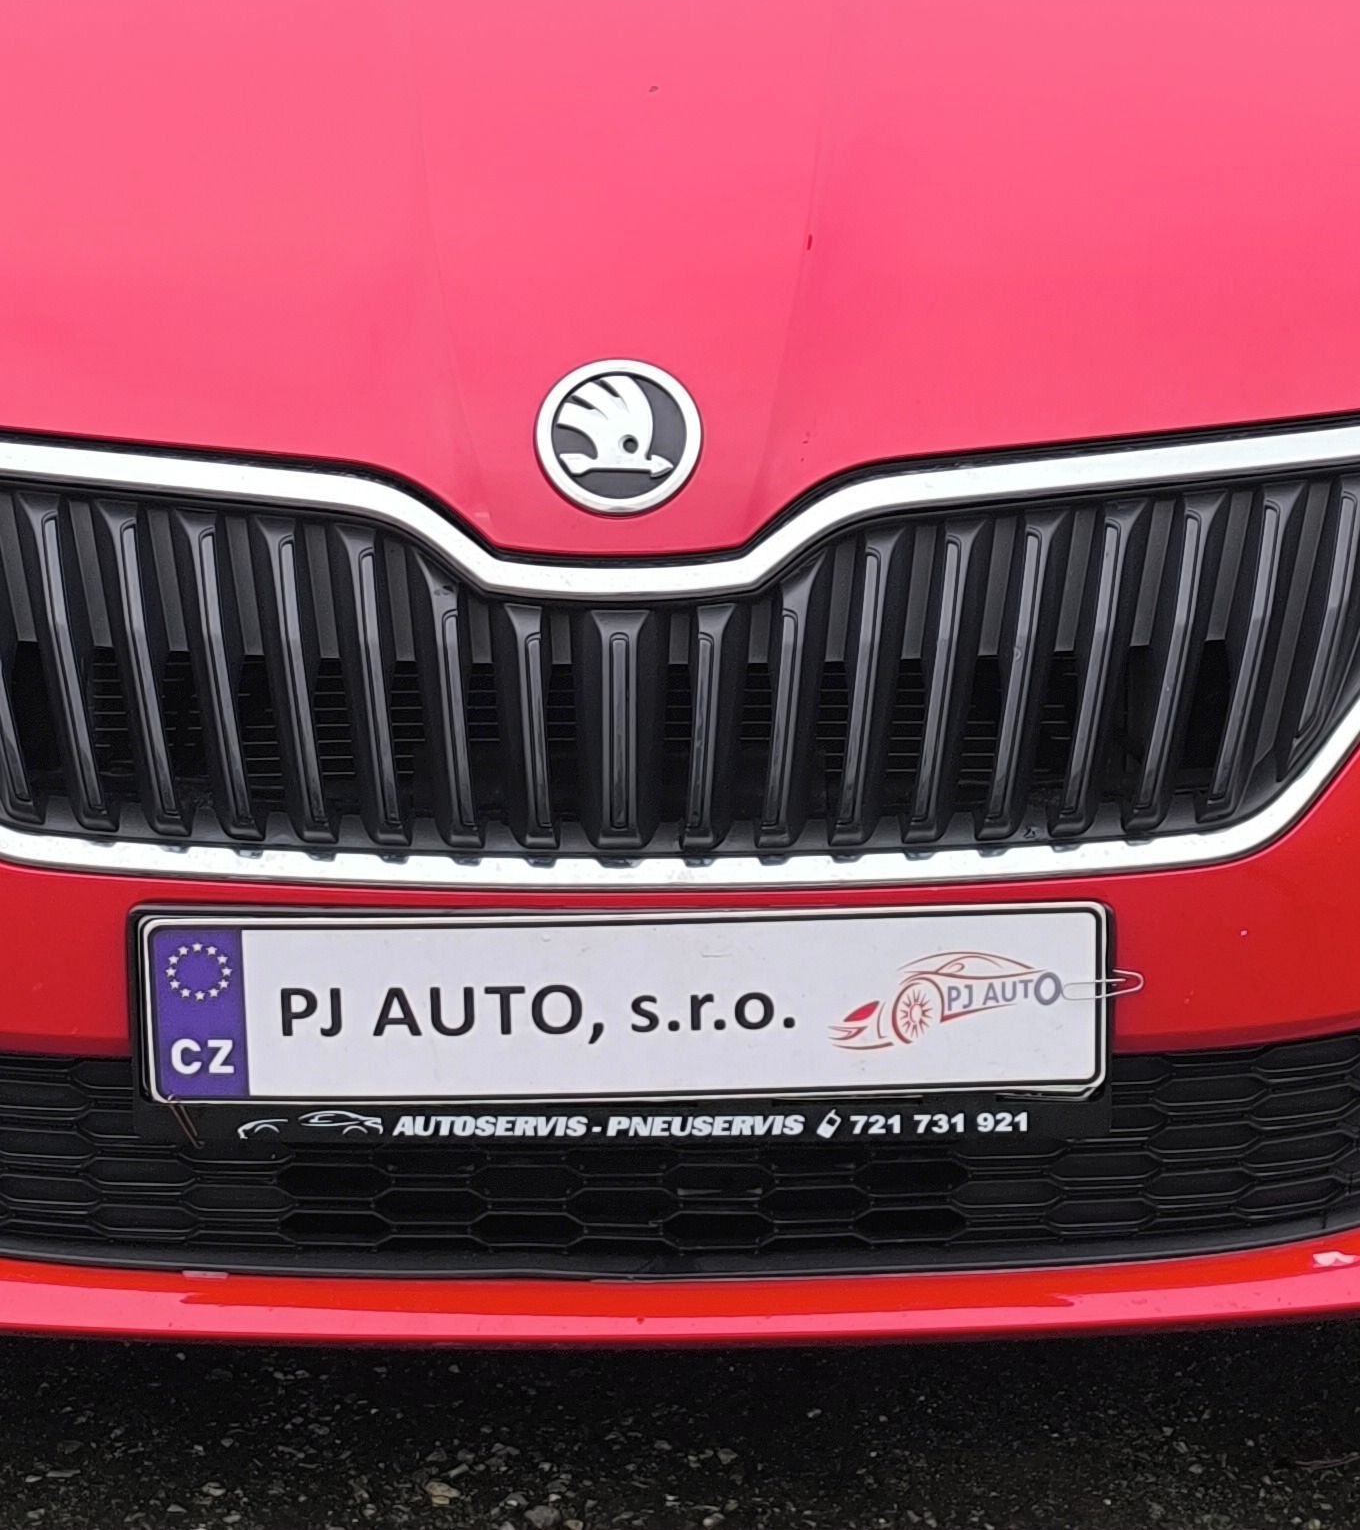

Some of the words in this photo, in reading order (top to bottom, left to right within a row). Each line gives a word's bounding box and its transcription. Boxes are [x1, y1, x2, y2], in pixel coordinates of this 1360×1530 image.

[947, 984, 973, 1011] PJ
[982, 972, 1063, 1006] AUTO
[280, 986, 343, 1037] PJ
[372, 983, 606, 1045] AUTO,
[630, 990, 797, 1033] s.r.o.
[170, 1038, 235, 1076] CZ
[392, 1115, 589, 1137] AUTOSERVIS
[606, 1114, 806, 1137] PNEUSERVIS
[849, 1114, 901, 1135] 721
[913, 1112, 965, 1134] 731
[976, 1111, 1028, 1133] 921
